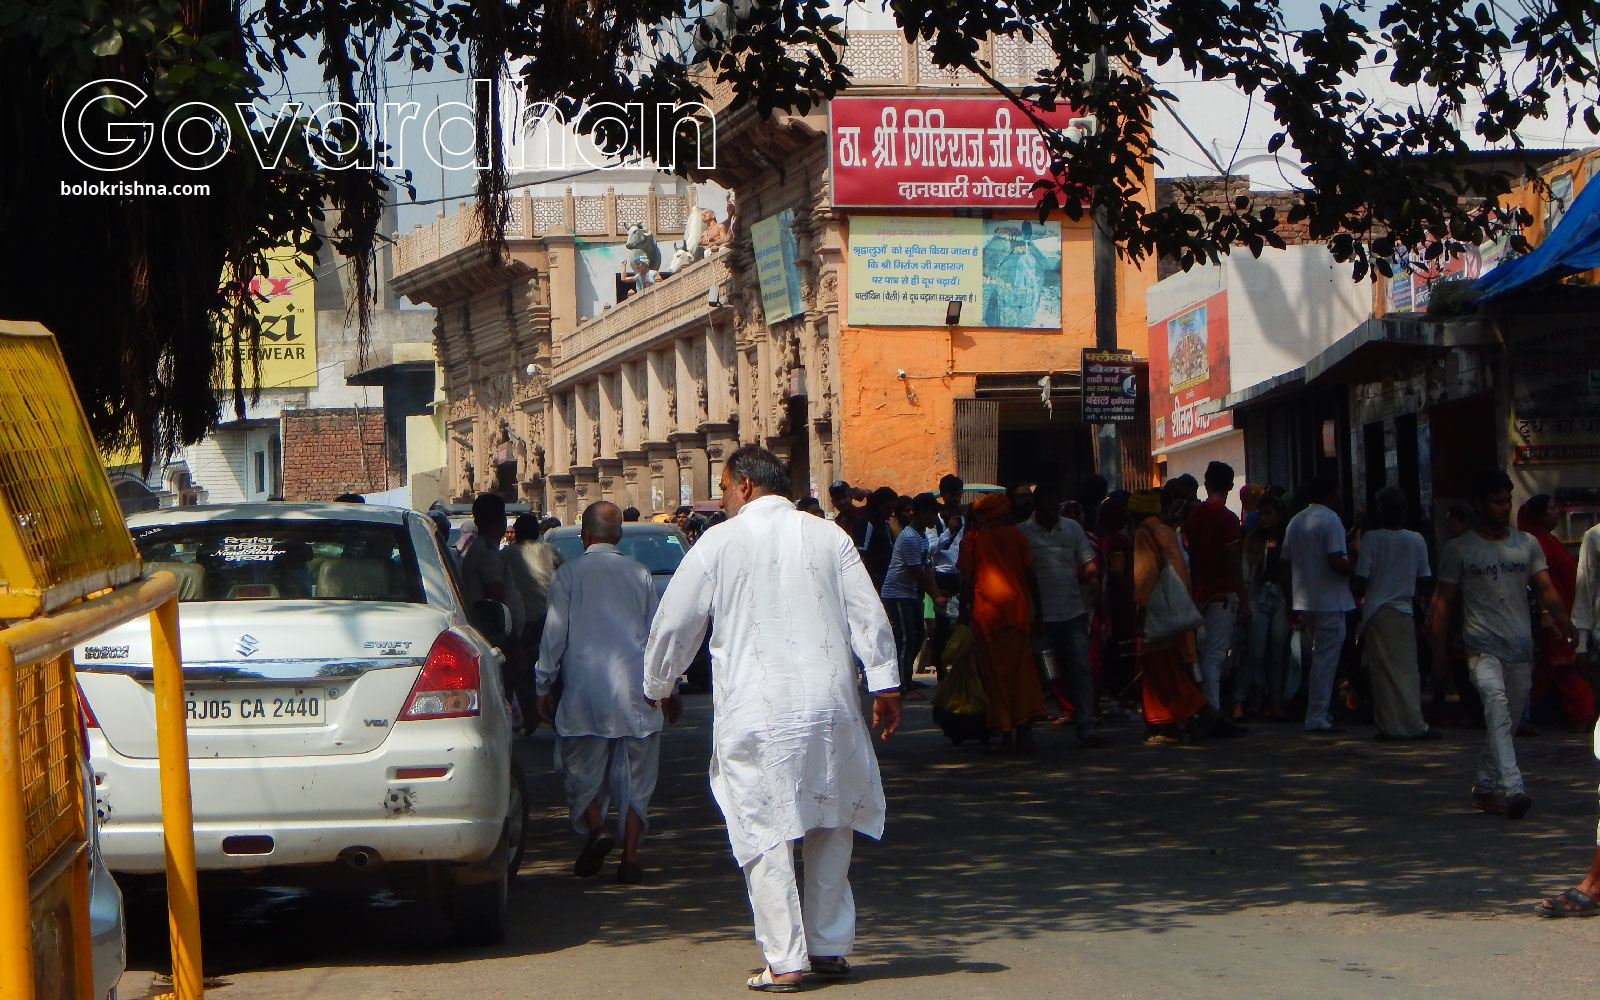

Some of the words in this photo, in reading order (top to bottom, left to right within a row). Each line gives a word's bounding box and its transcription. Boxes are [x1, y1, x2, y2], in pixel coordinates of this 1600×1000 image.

[838, 126, 867, 168] ठा.
[872, 106, 898, 169] श्री
[903, 108, 985, 168] गिरिराज
[987, 108, 1013, 168] जी
[898, 175, 969, 200] दानघाटी
[972, 176, 1034, 199] गोवर्धन
[891, 245, 902, 255] को
[904, 244, 927, 257] सूचित
[929, 245, 949, 255] किया
[951, 246, 970, 256] जाता
[867, 259, 878, 269] कि
[881, 259, 891, 270] श्री
[920, 259, 932, 270] जी
[934, 262, 964, 271] महाराज
[872, 276, 883, 285] पर
[885, 276, 899, 285] पात्र
[901, 275, 908, 285] से
[910, 274, 920, 286] ही
[922, 276, 934, 288] दूध
[902, 290, 908, 301] से
[909, 292, 919, 304] दूध
[364, 641, 412, 649] SWIFT
[185, 699, 231, 719] RJ05
[240, 699, 265, 718] CA
[273, 698, 319, 717] 2440
